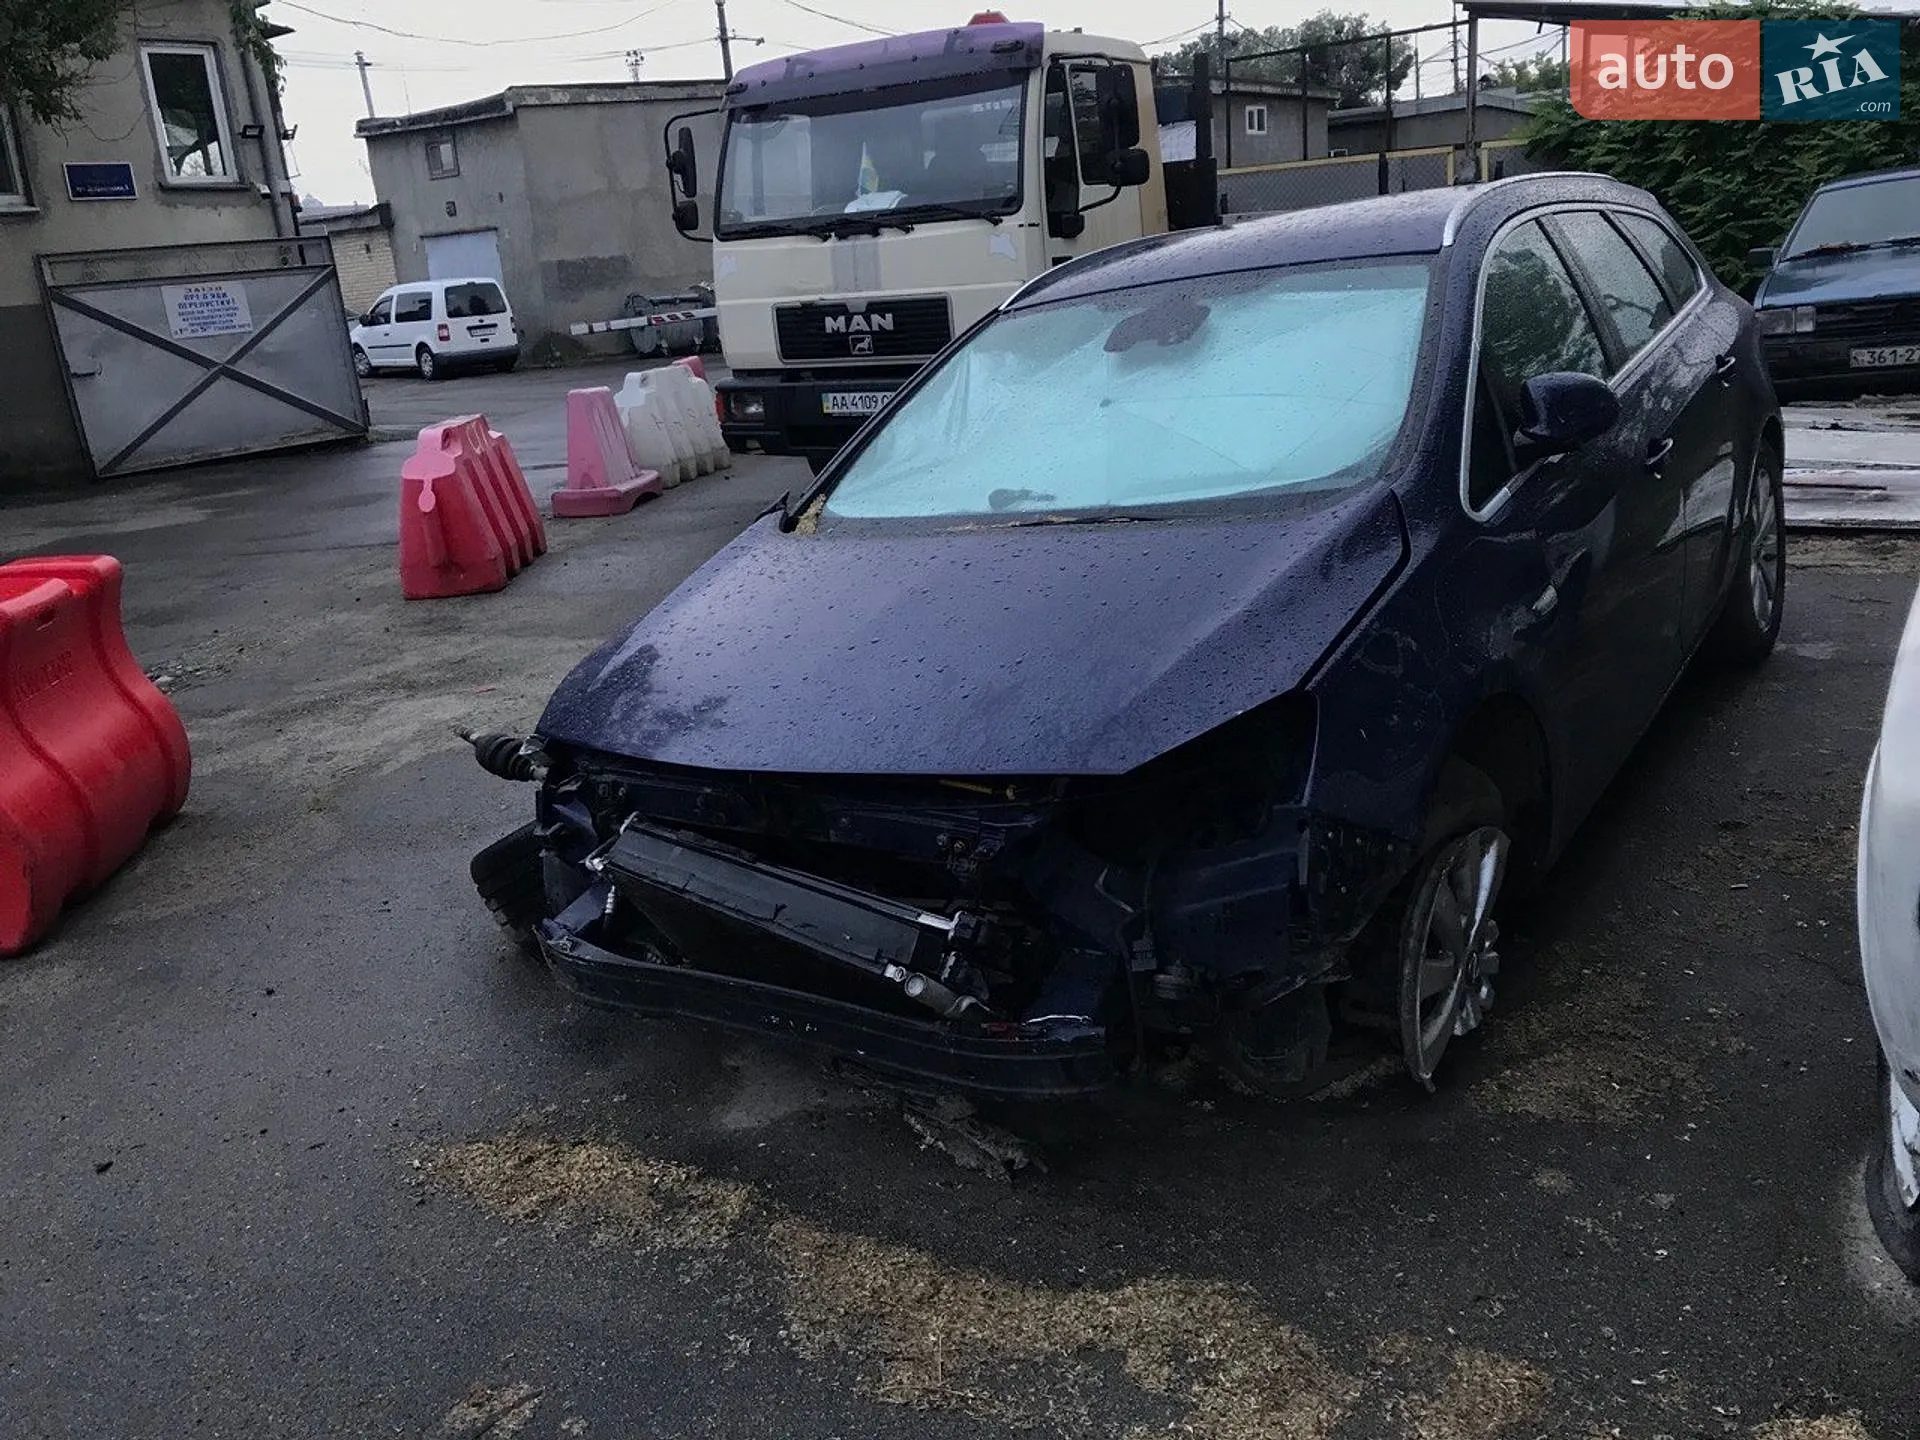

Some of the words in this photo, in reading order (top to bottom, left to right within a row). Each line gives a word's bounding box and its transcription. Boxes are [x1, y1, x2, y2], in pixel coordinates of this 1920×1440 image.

[825, 313, 894, 333] MAN
[1867, 347, 1920, 364] 361-2
[832, 396, 848, 409] AA
[851, 395, 878, 409] 4109
